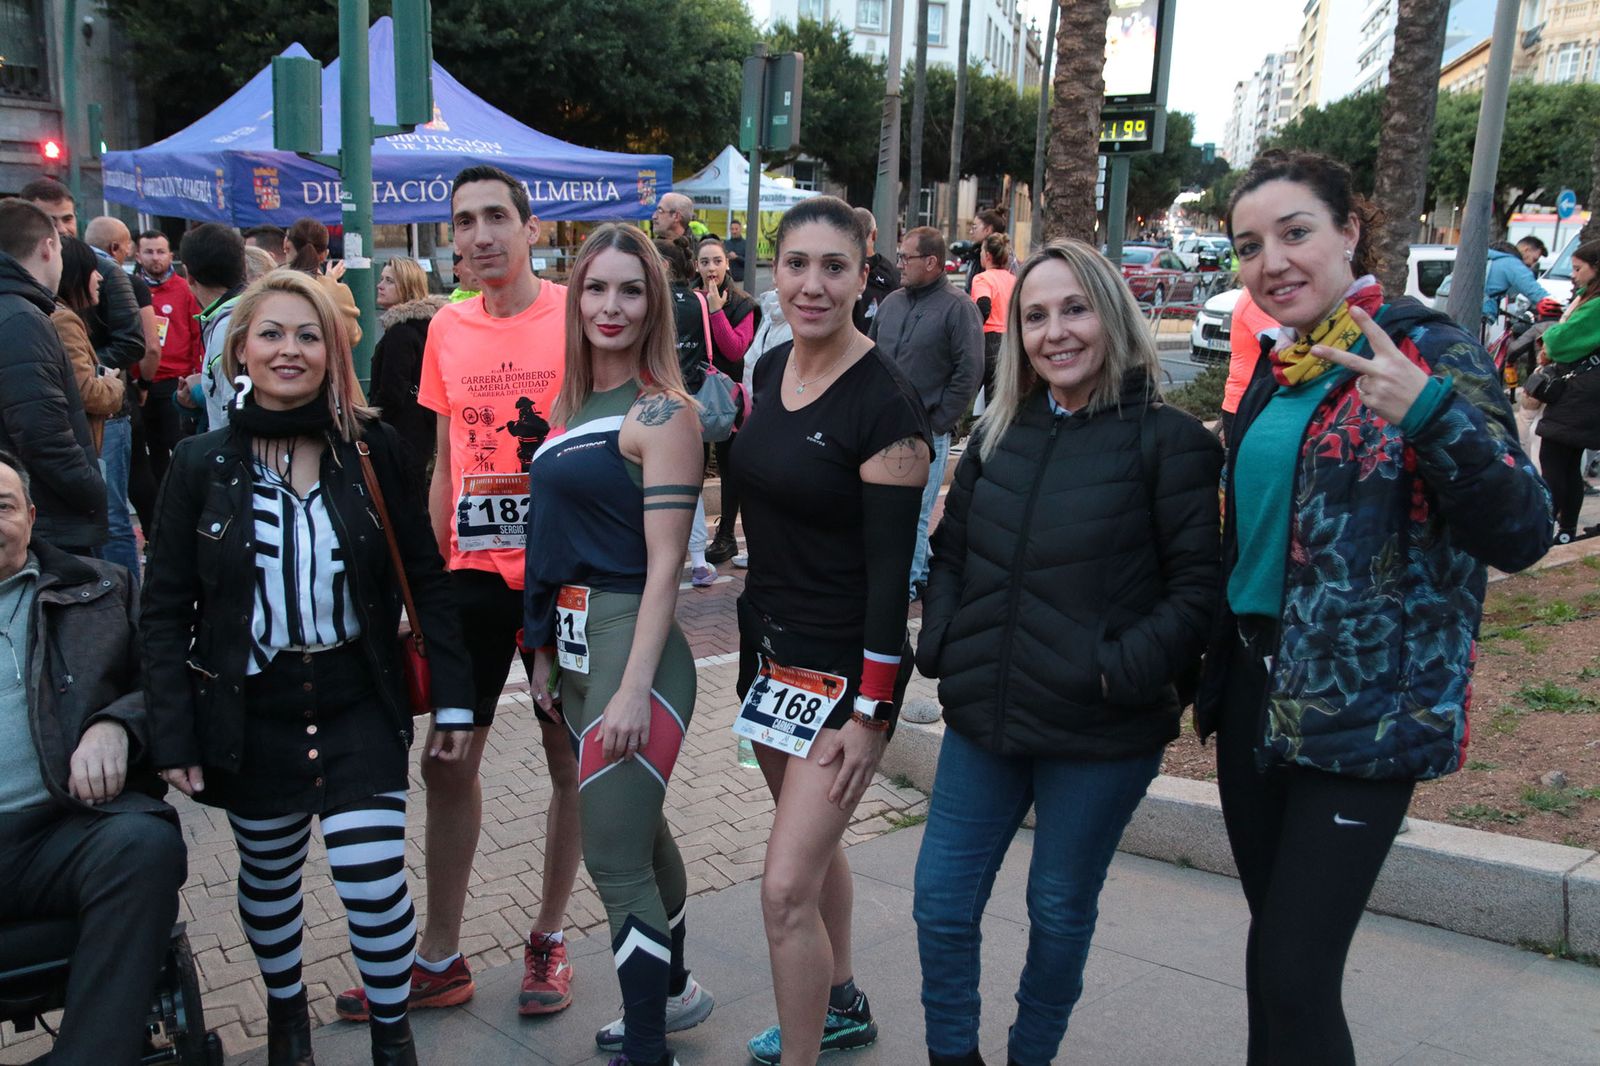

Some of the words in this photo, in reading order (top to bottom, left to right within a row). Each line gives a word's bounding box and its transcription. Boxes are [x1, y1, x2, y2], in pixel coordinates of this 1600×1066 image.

[391, 142, 419, 150] DE
[521, 176, 621, 201] ALMERÍA
[461, 375, 503, 385] CARRERA
[505, 370, 556, 382] BOMBEROS
[512, 380, 549, 389] CIUDAD
[499, 524, 525, 535] SERGIO
[772, 688, 822, 724] 168
[772, 718, 797, 734] CARMEN
